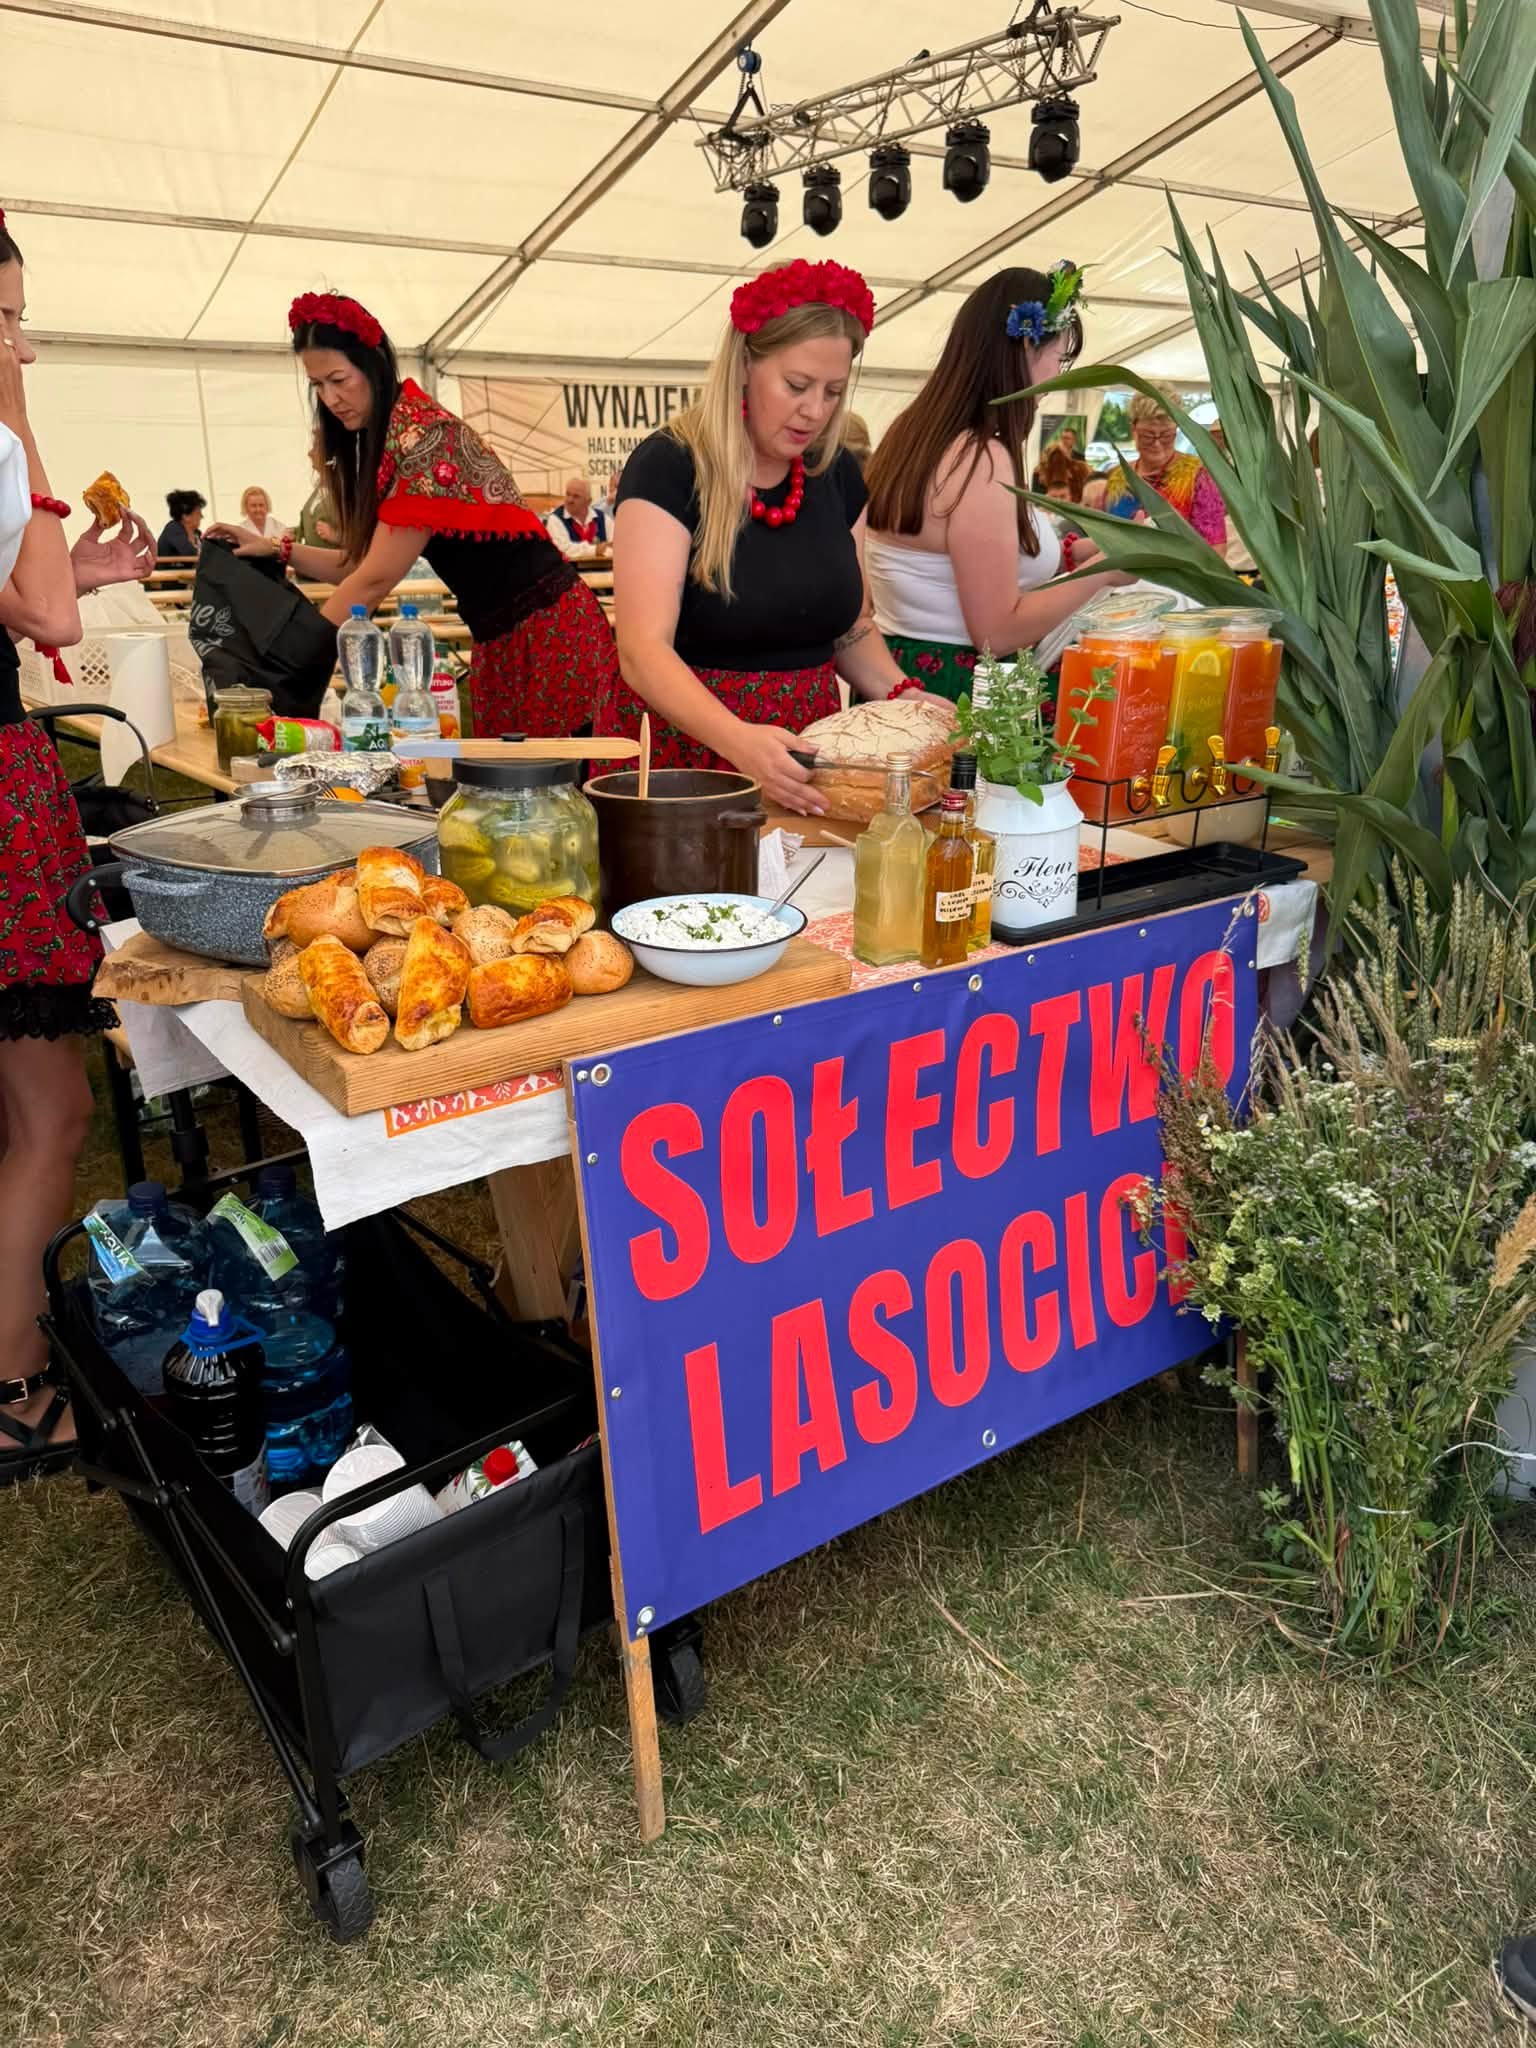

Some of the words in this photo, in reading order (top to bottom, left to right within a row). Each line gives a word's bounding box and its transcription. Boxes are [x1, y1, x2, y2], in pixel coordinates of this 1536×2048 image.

[587, 437, 616, 454] HALE
[1013, 856, 1072, 878] Fleur
[620, 950, 1236, 1302] SOŁECTWO
